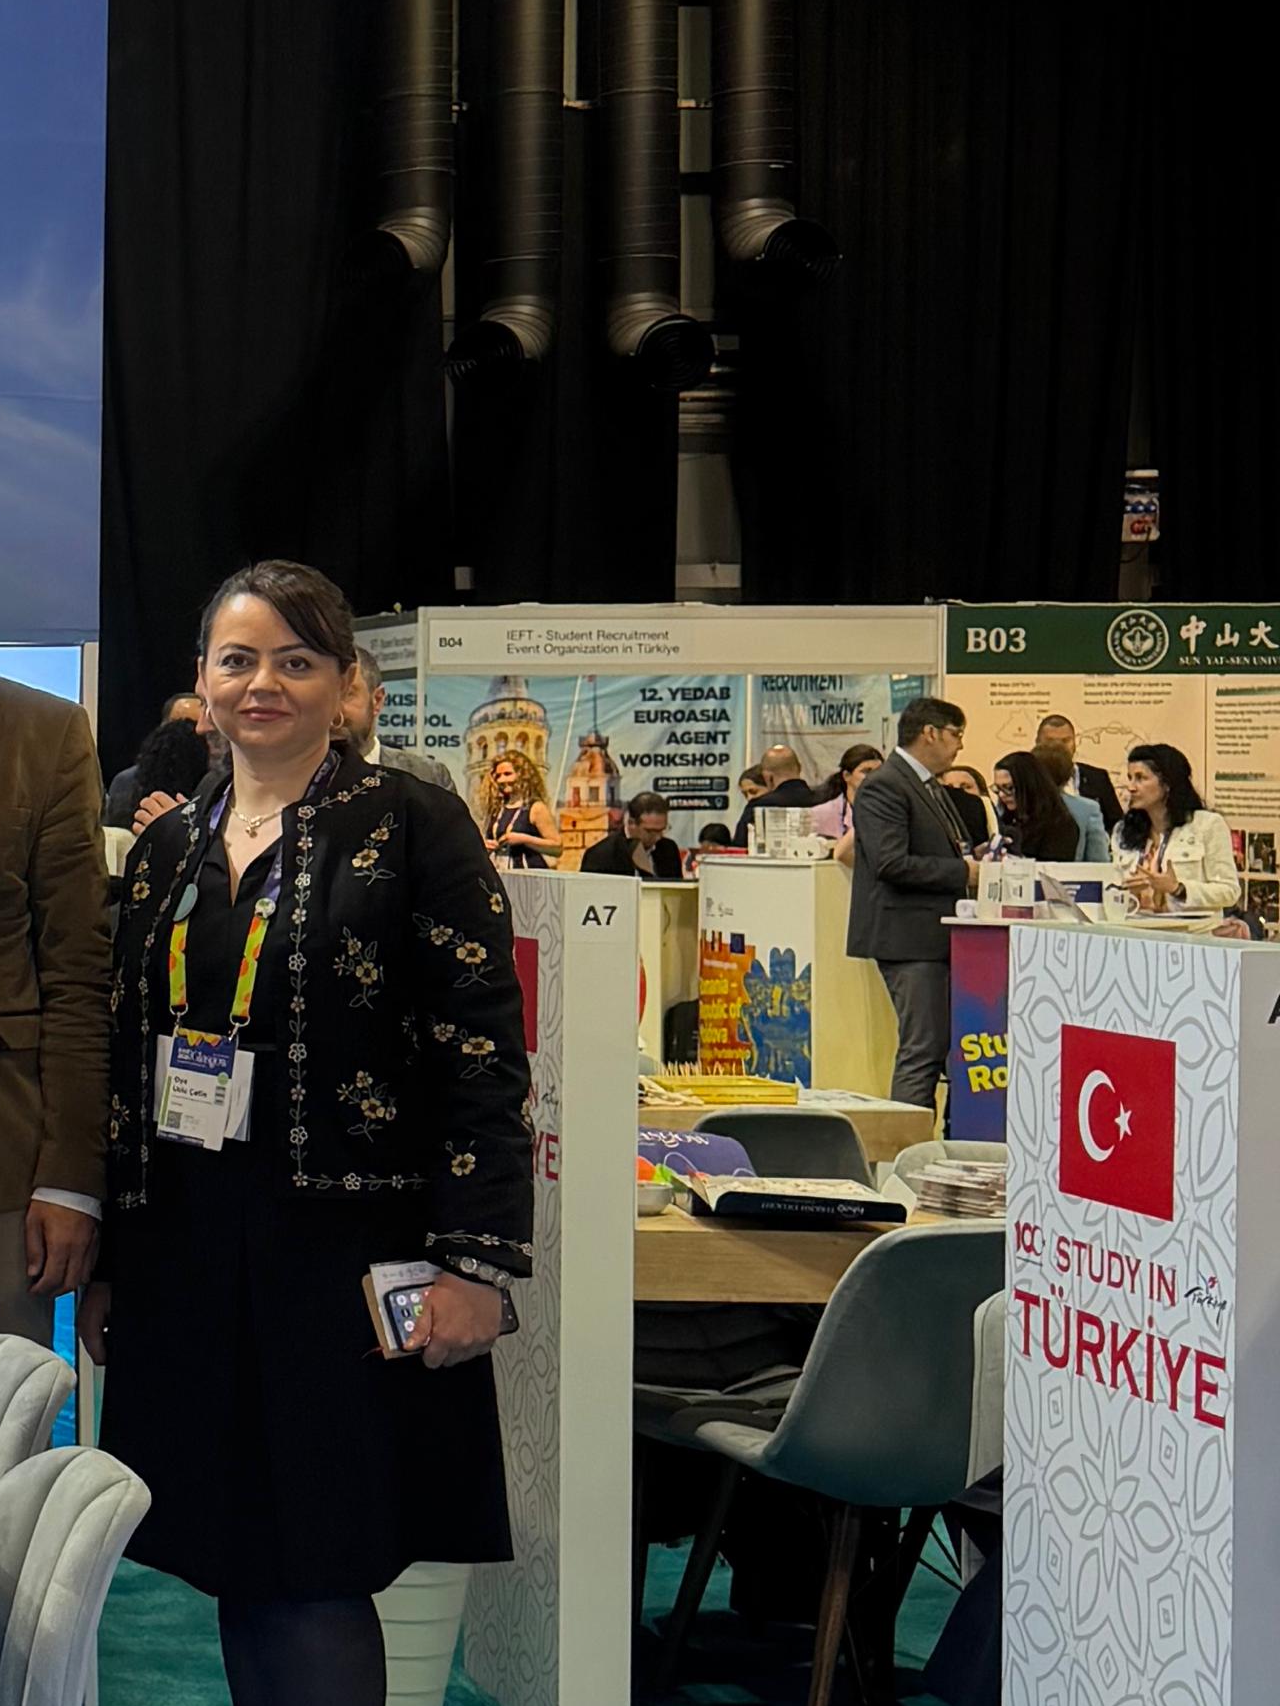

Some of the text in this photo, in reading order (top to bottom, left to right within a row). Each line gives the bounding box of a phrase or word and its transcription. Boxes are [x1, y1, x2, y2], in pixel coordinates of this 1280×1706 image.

[439, 637, 463, 648] B04
[507, 630, 533, 640] IEFT
[546, 630, 592, 641] Student
[597, 630, 669, 641] Recruitment
[966, 627, 1026, 653] B03
[507, 644, 540, 654] Event
[544, 643, 618, 656] Organization
[638, 643, 680, 656] Türkiye
[639, 686, 730, 702] 12. YEDAB
[634, 709, 730, 723] EUROASIA
[666, 731, 730, 745] AGENT
[620, 753, 730, 768] WORKSHOP
[582, 905, 618, 927] A7
[1056, 1235, 1140, 1296] STUDY
[1148, 1262, 1177, 1307] IN
[1014, 1283, 1226, 1430] TÜRKİYE
